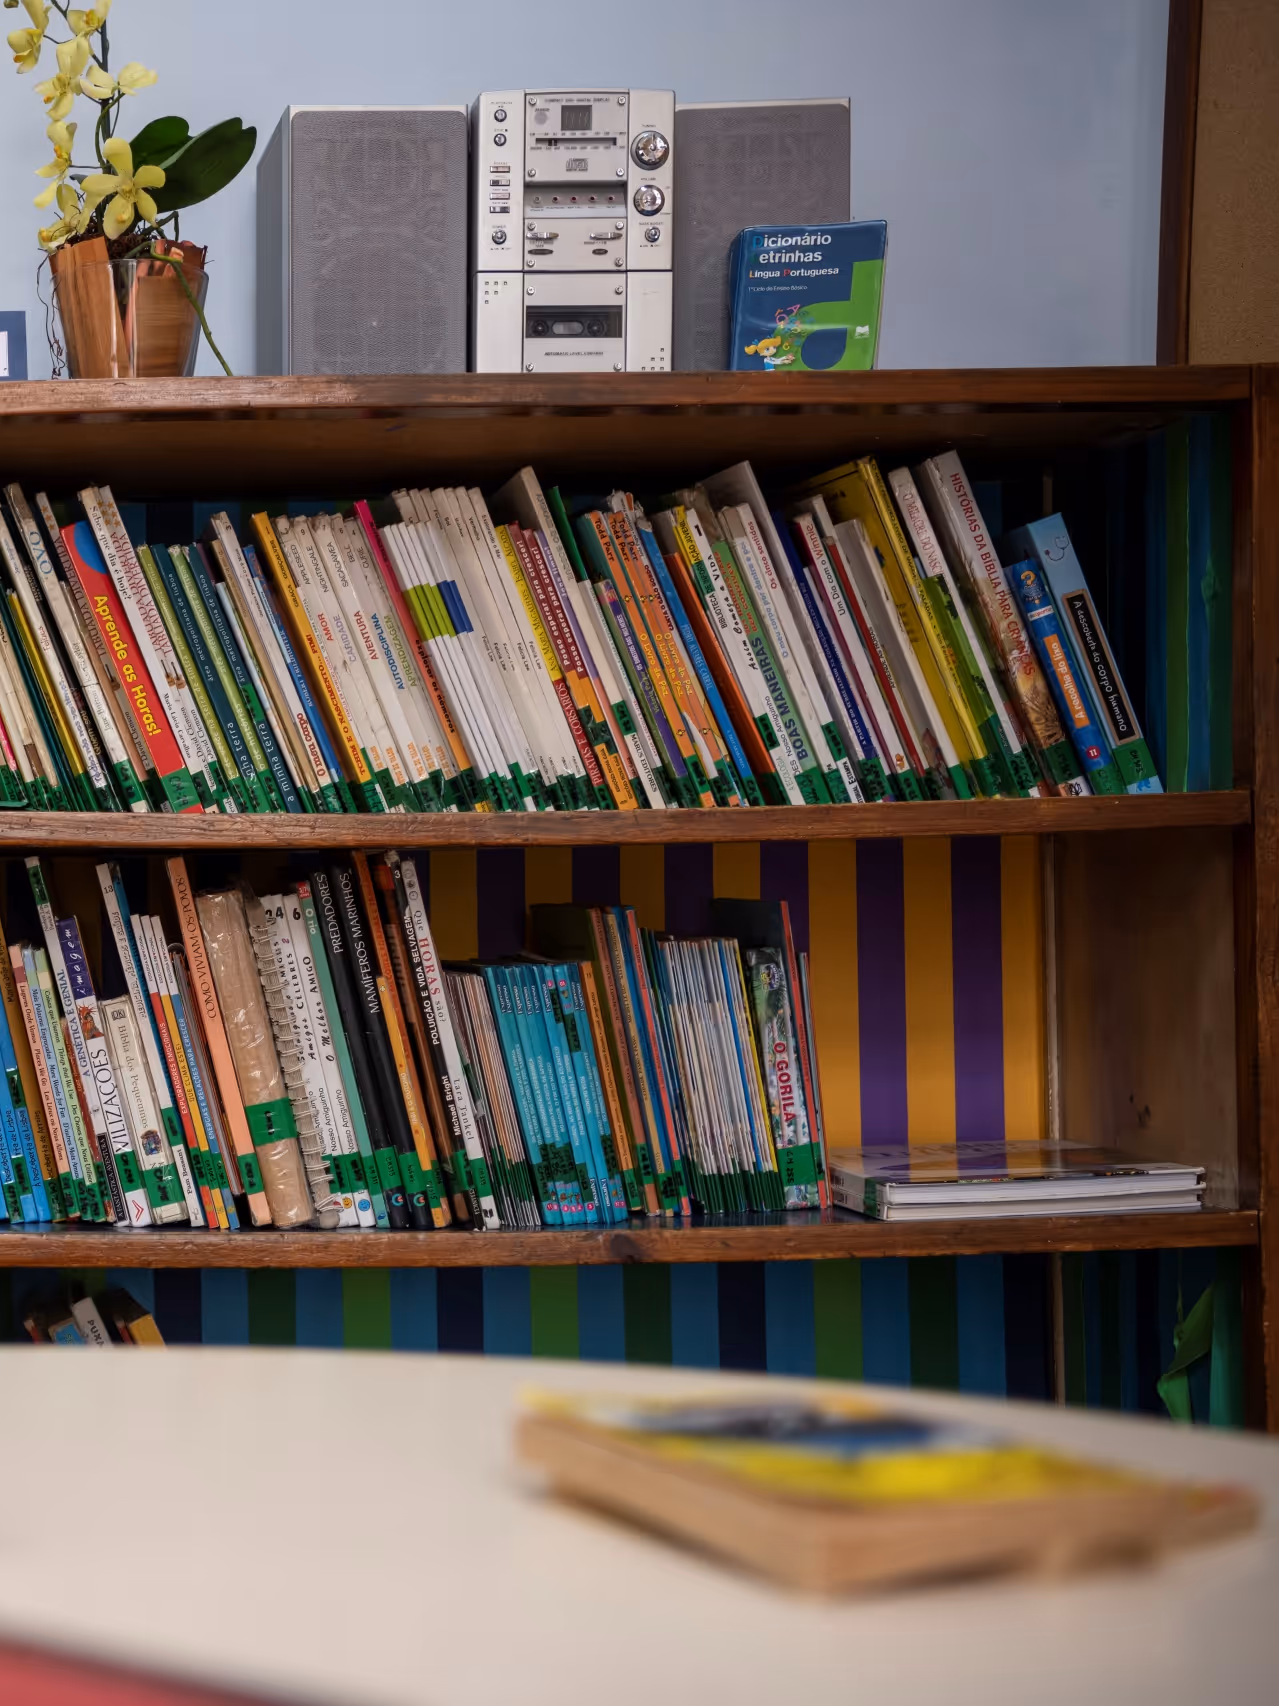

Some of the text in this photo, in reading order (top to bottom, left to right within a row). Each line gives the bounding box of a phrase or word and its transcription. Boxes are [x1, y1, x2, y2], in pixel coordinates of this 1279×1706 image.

[752, 232, 832, 248] Dicionário
[749, 267, 839, 280] Língua Portuguesa
[947, 471, 983, 533] HISTÓRIAS
[87, 505, 132, 601] Sabes que dia é hoje?
[289, 543, 312, 585] APPLESEED
[325, 541, 349, 587] SACAGAWEA
[356, 546, 370, 568] CURIE
[592, 518, 617, 562] Todd Parr
[608, 518, 631, 562] Todd Parr
[616, 518, 641, 561] Todd Parr
[745, 520, 779, 589] Os cinco sentidos
[804, 523, 824, 558] Winnie
[972, 533, 987, 551] DA
[117, 532, 172, 655] TABUADA DIVERTIDA
[305, 544, 329, 593] NIGHTINGALE
[821, 565, 834, 584] com
[828, 584, 840, 600] Dia
[979, 550, 1004, 589] BÍBLIA
[51, 535, 107, 658] TABUADA DIVERTIDA
[515, 539, 571, 666] Posso esperar para crescer!
[529, 545, 585, 672] Posso esperar para crescer!
[834, 600, 846, 616] Um
[993, 589, 1013, 619] PARA
[166, 572, 214, 682] área metropolitana de lisboa
[316, 612, 334, 642] AMOR
[332, 614, 357, 662] CARIDADE
[352, 610, 379, 661] AVENTURA
[370, 613, 405, 690] AUTODISCIPLINA
[383, 614, 417, 687] APRENDIZAGEM
[1003, 619, 1036, 676] CRIANÇAS
[90, 591, 162, 736] Aprende as Horas!
[413, 637, 457, 733] explorar os números
[638, 632, 670, 696] O Livro da Paz
[653, 633, 685, 697] O Livro da Paz
[1048, 641, 1085, 720] A recolha do lixo
[305, 633, 366, 776] TCHIM E O NASCIMENTO... PIM!
[749, 636, 808, 760] BOAS MANEIRAS
[79, 709, 102, 755] Quem sou
[295, 710, 325, 777] O meu corpo
[553, 681, 604, 784] PIRATAS E CORSÁRIOS
[257, 722, 295, 802] a minha terra
[293, 908, 301, 920] 6
[304, 907, 318, 935] O rio
[316, 873, 344, 953] PREDADORES
[403, 914, 422, 963] SELVAGEM
[338, 871, 380, 1013] MAMÍFEROS MARINHOS
[412, 909, 447, 1023] Que HORAS são?
[56, 969, 72, 1007] GENIAL
[414, 965, 427, 987] VIDA
[177, 1017, 191, 1047] CRESCER
[284, 952, 318, 1061] Amigos CÉLEBRES
[300, 955, 335, 1062] O Melhor AMIGO
[422, 999, 440, 1045] POLUIÇÃO
[33, 1048, 48, 1086] Places We Go
[67, 1016, 87, 1068] GENÉTICA
[158, 1021, 188, 1114] EXPLORADORES EMOCIONAIS
[185, 1048, 196, 1065] PARA
[771, 1041, 785, 1054] O
[56, 1047, 75, 1100] Things that We Use
[82, 1069, 90, 1077] A
[116, 1024, 150, 1129] Bíblia dos Pequeninos
[190, 1066, 205, 1100] RELAÇÕES
[775, 1059, 797, 1122] GORILA
[201, 1106, 215, 1139] ENERGIAS
[315, 1086, 339, 1151] Nosso Amiguinho
[332, 1088, 357, 1153] Nosso Amiguinho
[440, 1074, 461, 1136] Michael Bright
[98, 1138, 112, 1171] AVENTURA
[106, 1170, 122, 1212] FANTÁSTICA
